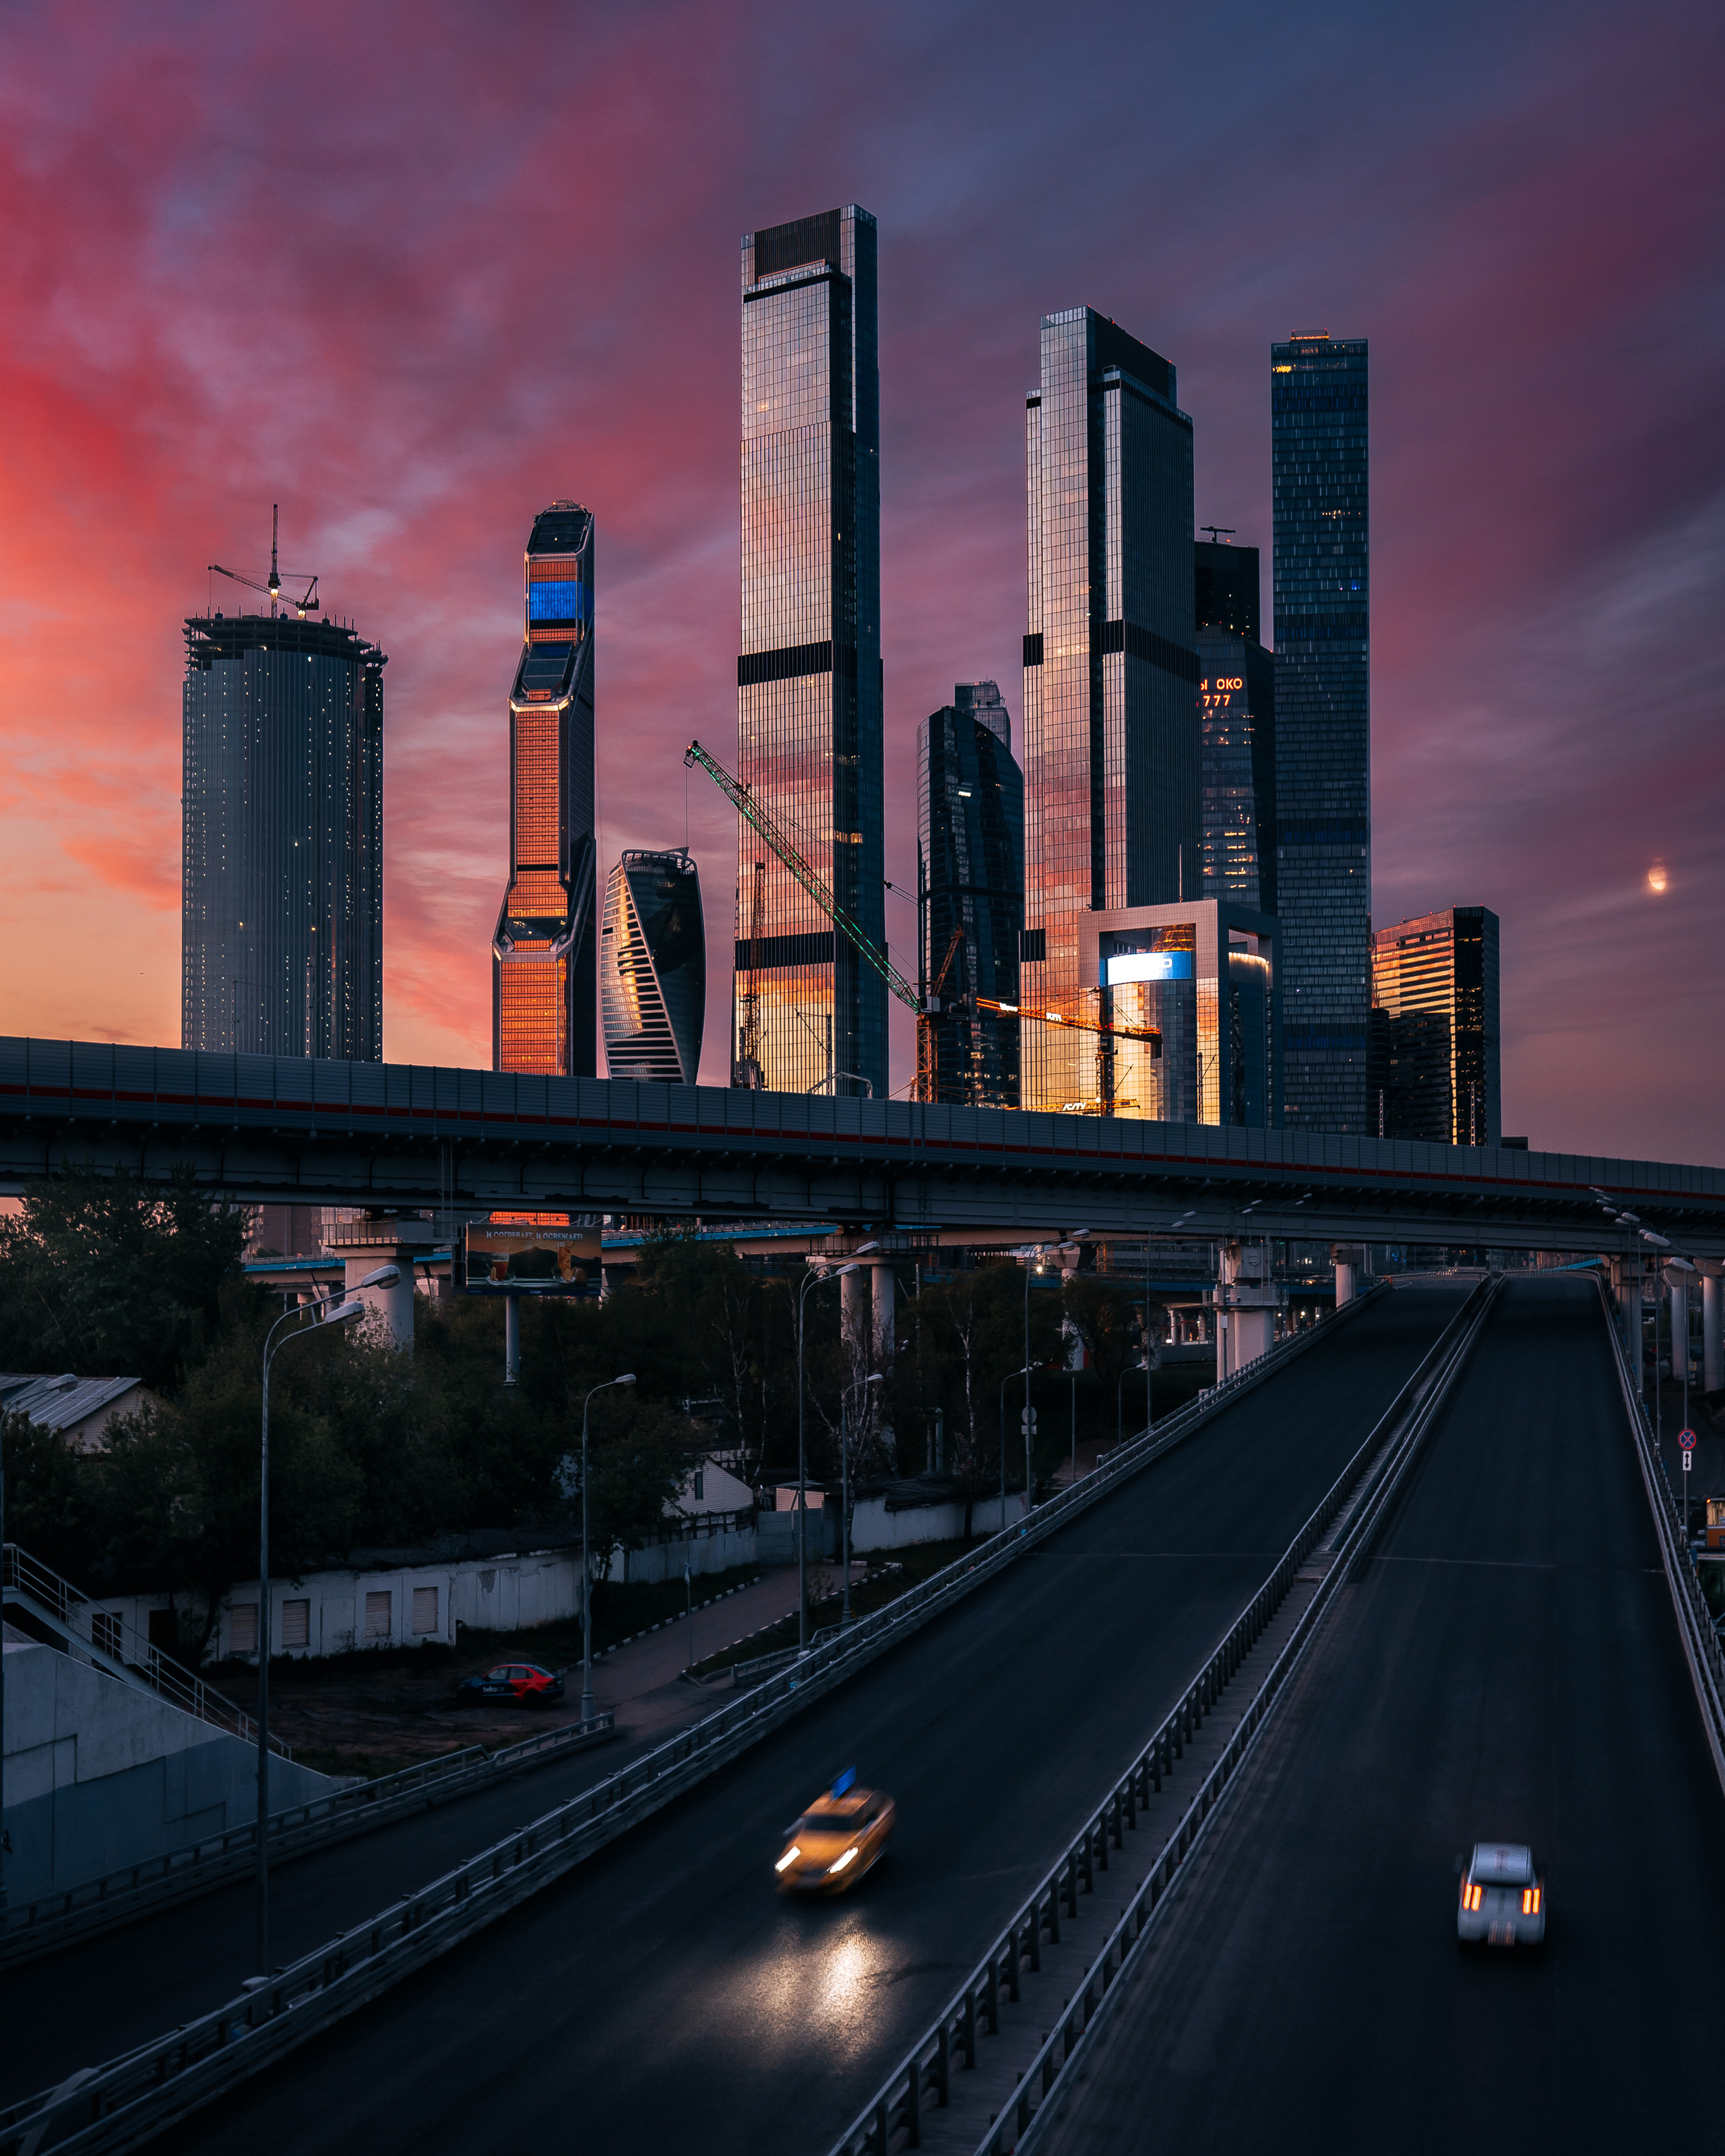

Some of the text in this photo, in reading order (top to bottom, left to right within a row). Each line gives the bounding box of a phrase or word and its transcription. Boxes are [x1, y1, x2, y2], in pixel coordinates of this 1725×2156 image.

[1216, 678, 1243, 690] ОКО
[1203, 695, 1230, 707] 777
[536, 1232, 541, 1240] И
